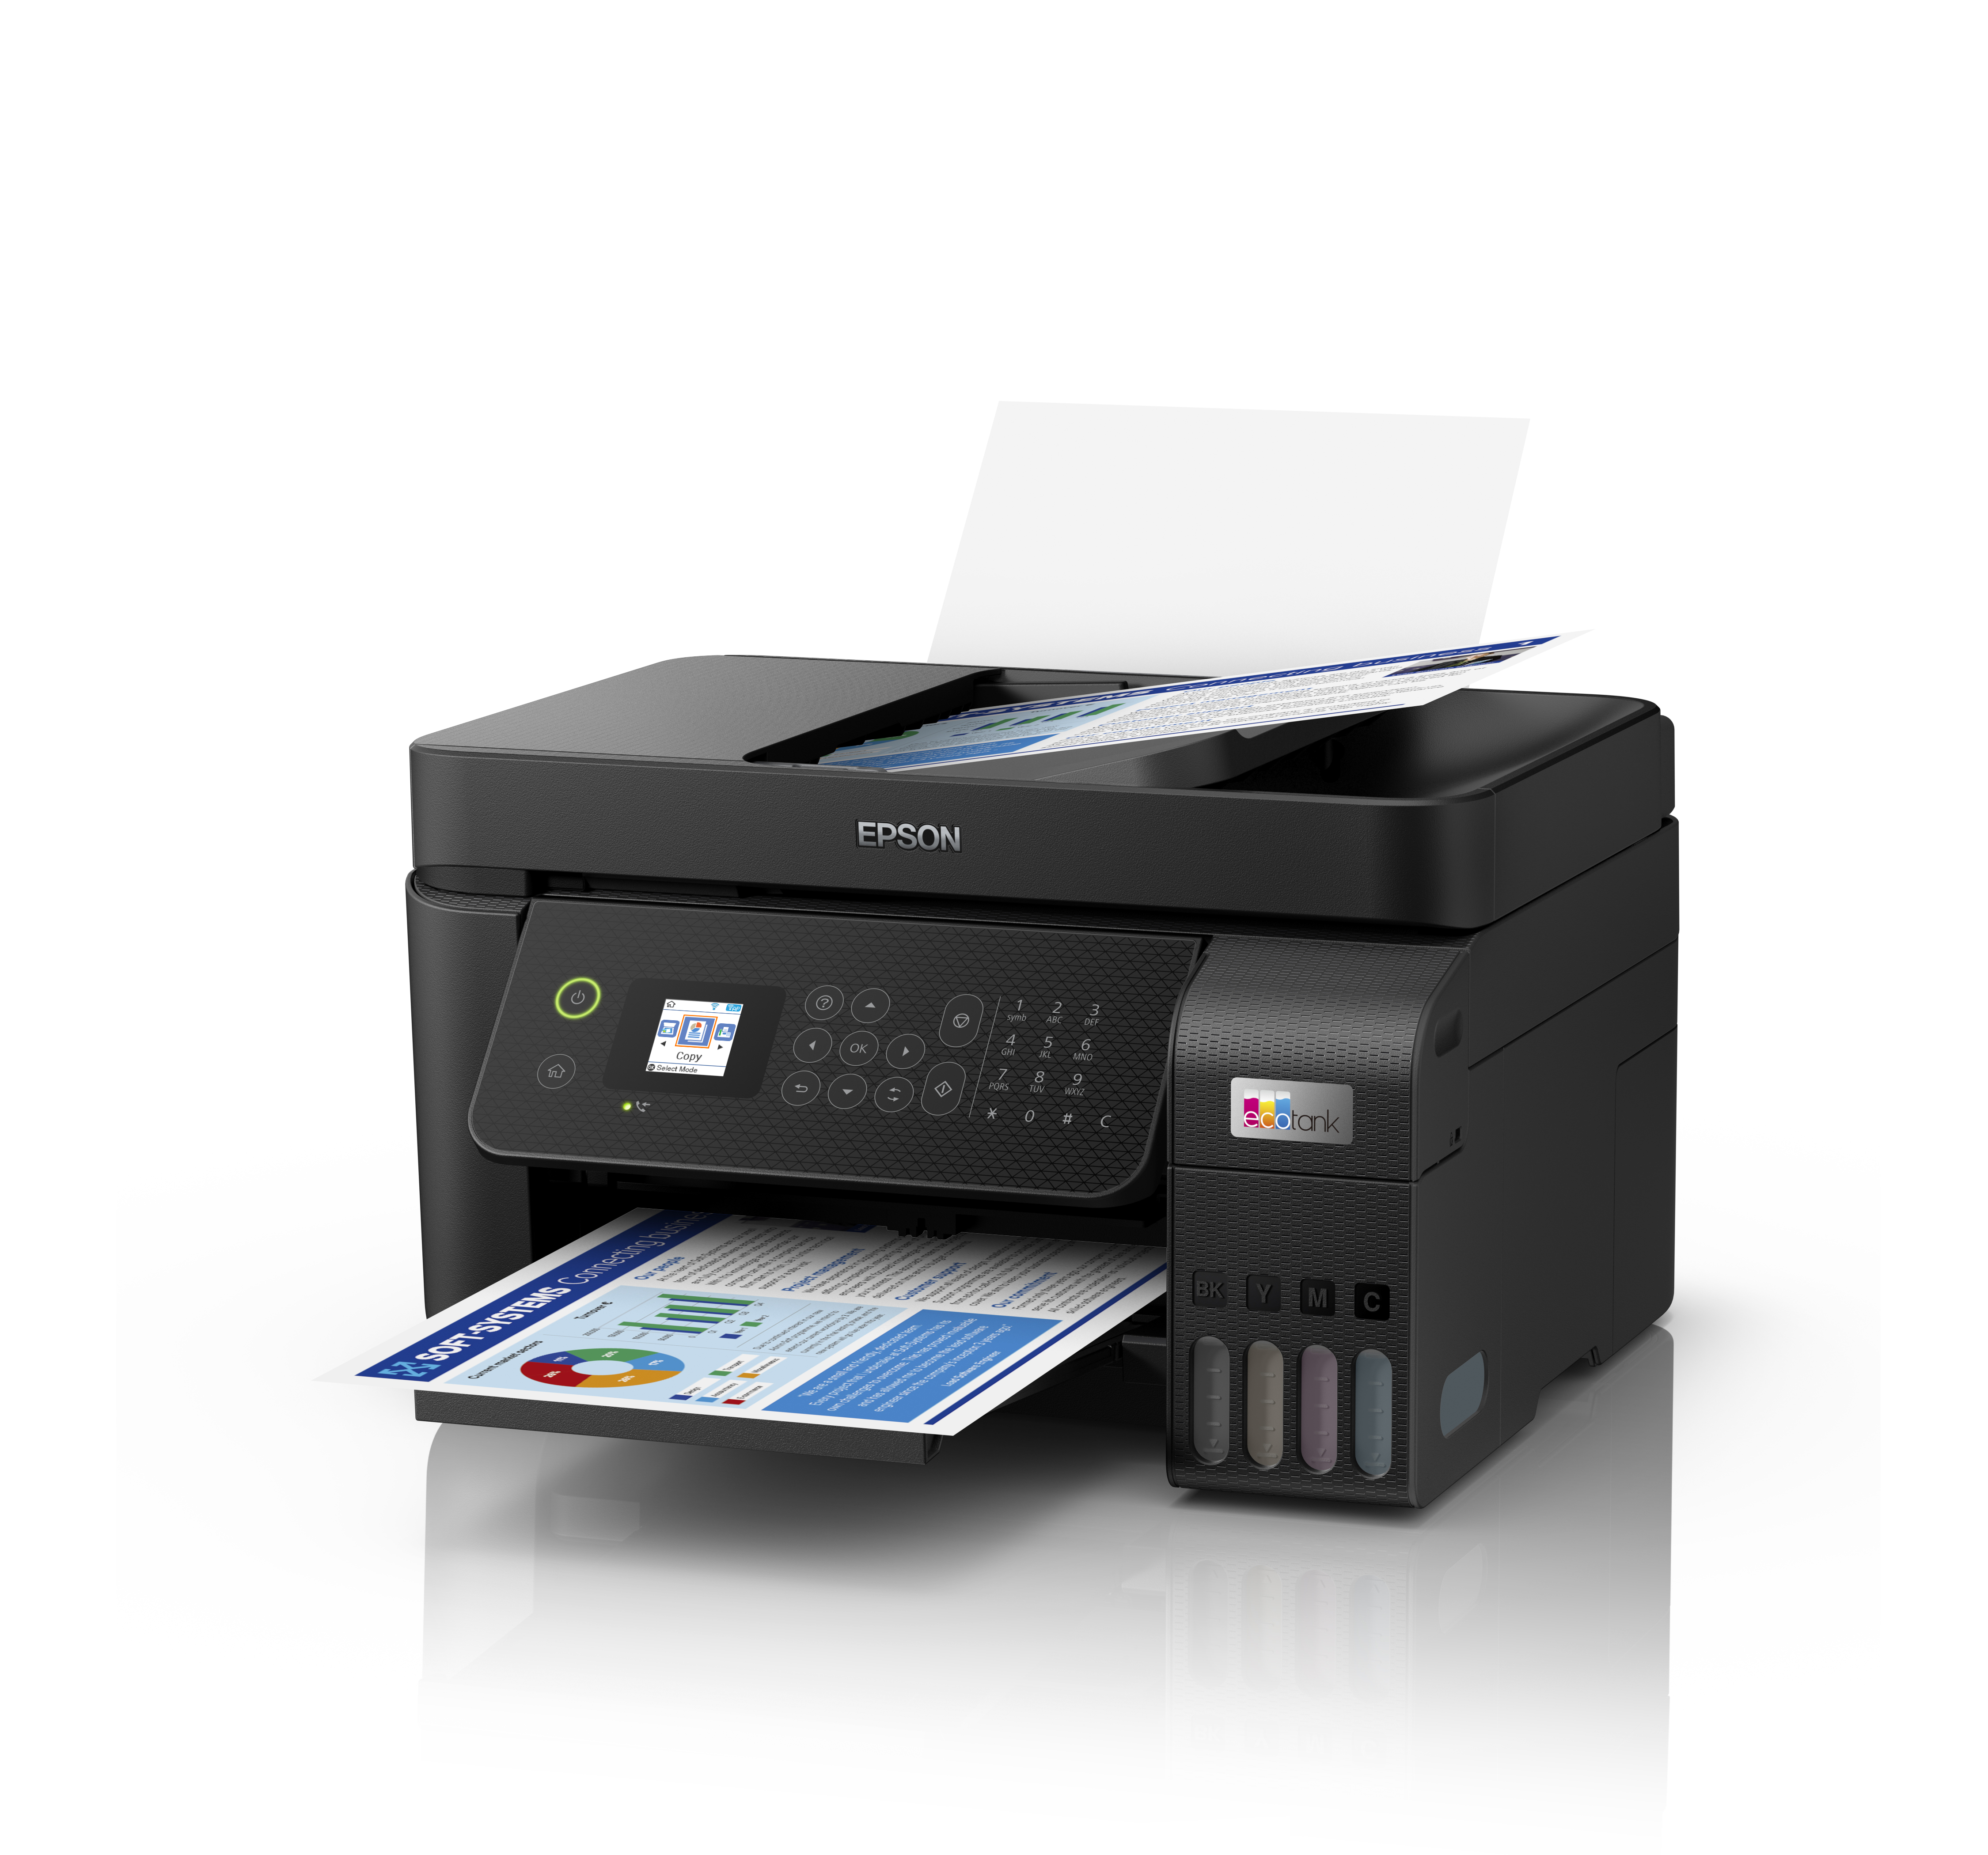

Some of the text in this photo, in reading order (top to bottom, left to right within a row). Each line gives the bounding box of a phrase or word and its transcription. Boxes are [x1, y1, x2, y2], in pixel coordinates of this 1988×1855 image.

[948, 689, 1153, 719] T-SYSTEMS
[1166, 666, 1344, 691] Connecting
[1352, 647, 1492, 667] business
[858, 822, 960, 852] EPSON
[1017, 1000, 1022, 1011] 1
[1052, 1002, 1062, 1013] 2
[1090, 1004, 1099, 1015] 3
[1007, 1014, 1026, 1022] symb
[1006, 1034, 1015, 1045] 4
[1043, 1037, 1053, 1048] 5
[1081, 1039, 1091, 1050] 6
[850, 1044, 868, 1053] OK
[677, 1052, 702, 1062] Copy
[998, 1068, 1007, 1080] 7
[1035, 1071, 1044, 1083] 8
[1073, 1074, 1082, 1085] 9
[989, 1083, 1009, 1091] PQRS
[1025, 1110, 1034, 1122] 0
[1062, 1113, 1073, 1124] #
[1100, 1115, 1111, 1127] C
[1244, 1109, 1339, 1133] ecotank
[690, 1245, 728, 1262] Soft-Systems
[740, 1227, 763, 1235] small
[634, 1257, 685, 1280] Our people
[781, 1248, 866, 1292] Project management
[758, 1278, 782, 1290] support
[895, 1262, 967, 1300] Customer support
[991, 1272, 1058, 1308] Our commitment
[1195, 1281, 1224, 1298] BK
[1256, 1284, 1270, 1303] Y
[415, 1287, 572, 1361] SOFT-SYSTEMS
[557, 1240, 665, 1284] Connecting
[1308, 1287, 1327, 1308] M
[1363, 1291, 1380, 1312] C
[574, 1305, 607, 1319] Turnover
[467, 1340, 543, 1379] Current market sectors
[827, 1370, 848, 1381] small
[851, 1351, 882, 1364] friendly,
[874, 1333, 907, 1351] dedicated
[900, 1325, 922, 1334] team.
[880, 1378, 907, 1393] allowed
[915, 1354, 945, 1368] become
[946, 1340, 967, 1348] lead
[961, 1325, 989, 1340] software
[722, 1360, 744, 1370] Transport
[751, 1358, 780, 1373] Miscellaneous
[808, 1395, 835, 1406] Every
[828, 1382, 854, 1396] project
[862, 1356, 895, 1374] undertake
[893, 1331, 935, 1352] Soft-Systems
[827, 1403, 845, 1411] own
[839, 1384, 875, 1403] challenges
[876, 1362, 910, 1380] overcome.
[926, 1335, 951, 1348] proved
[944, 1318, 978, 1335] invaluable
[941, 1351, 1001, 1386] Lead Software Engineer
[874, 1395, 904, 1412] engineer
[899, 1386, 919, 1396] since
[949, 1345, 982, 1361] inception
[980, 1333, 1001, 1343] years
[710, 1383, 739, 1397] Accountancy
[736, 1386, 763, 1399] E-commerce
